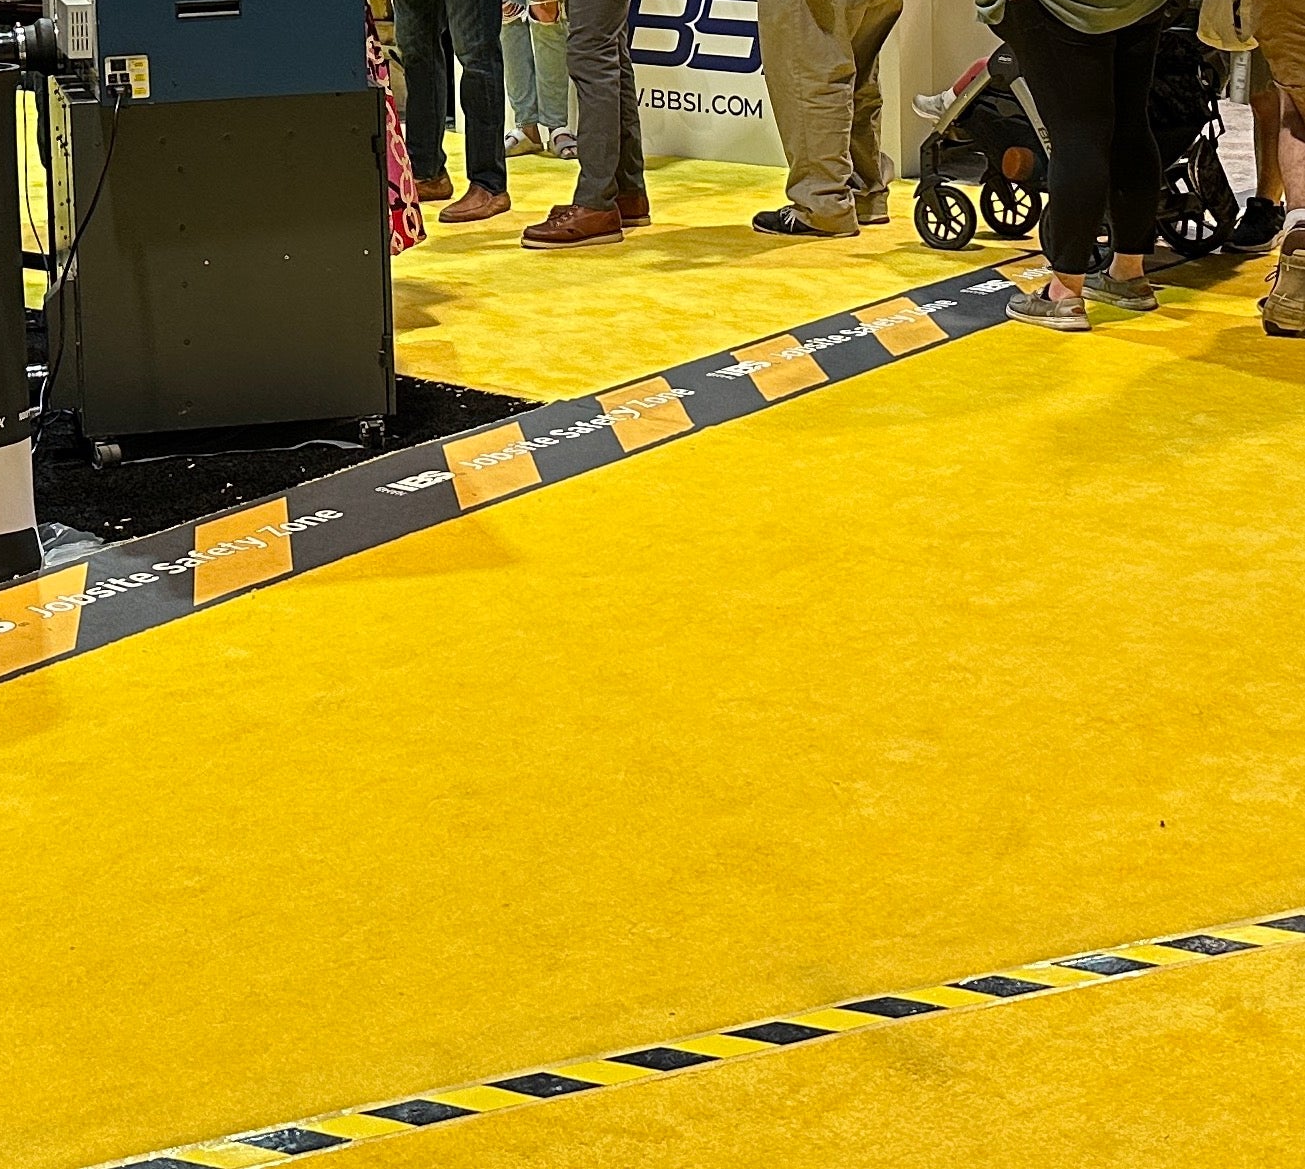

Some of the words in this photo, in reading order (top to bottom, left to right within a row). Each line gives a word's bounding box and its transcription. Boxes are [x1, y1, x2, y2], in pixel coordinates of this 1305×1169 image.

[780, 331, 852, 360] Jobsite
[840, 310, 915, 338] Safety
[909, 297, 958, 315] Zone
[392, 469, 456, 492] IBS
[459, 437, 560, 471] Jobsite
[549, 406, 641, 439] Safety
[636, 386, 696, 409] Zone
[29, 569, 159, 620] Jobsite
[152, 533, 269, 576] Safety
[259, 506, 344, 538] Zone
